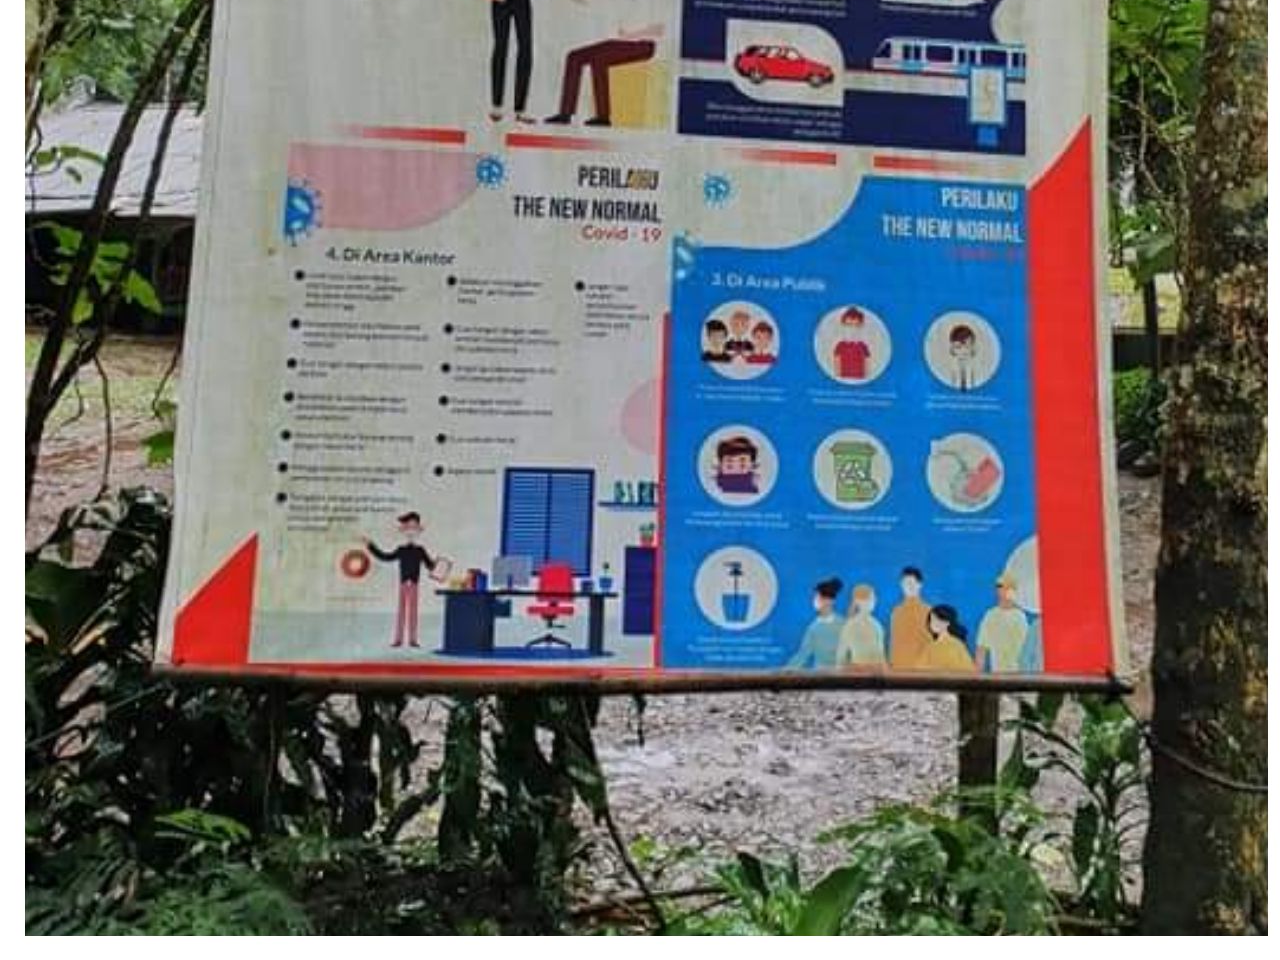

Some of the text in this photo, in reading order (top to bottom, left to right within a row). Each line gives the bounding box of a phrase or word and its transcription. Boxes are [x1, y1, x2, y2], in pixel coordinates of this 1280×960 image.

[514, 195, 662, 224] THE NEW NORMAL
[940, 188, 1019, 212] PERILAKU
[582, 225, 628, 240] Covid
[643, 227, 662, 242] 19
[882, 214, 1024, 244] THE NEW NORMAL
[363, 249, 400, 263] Area
[402, 249, 456, 265] Kantor
